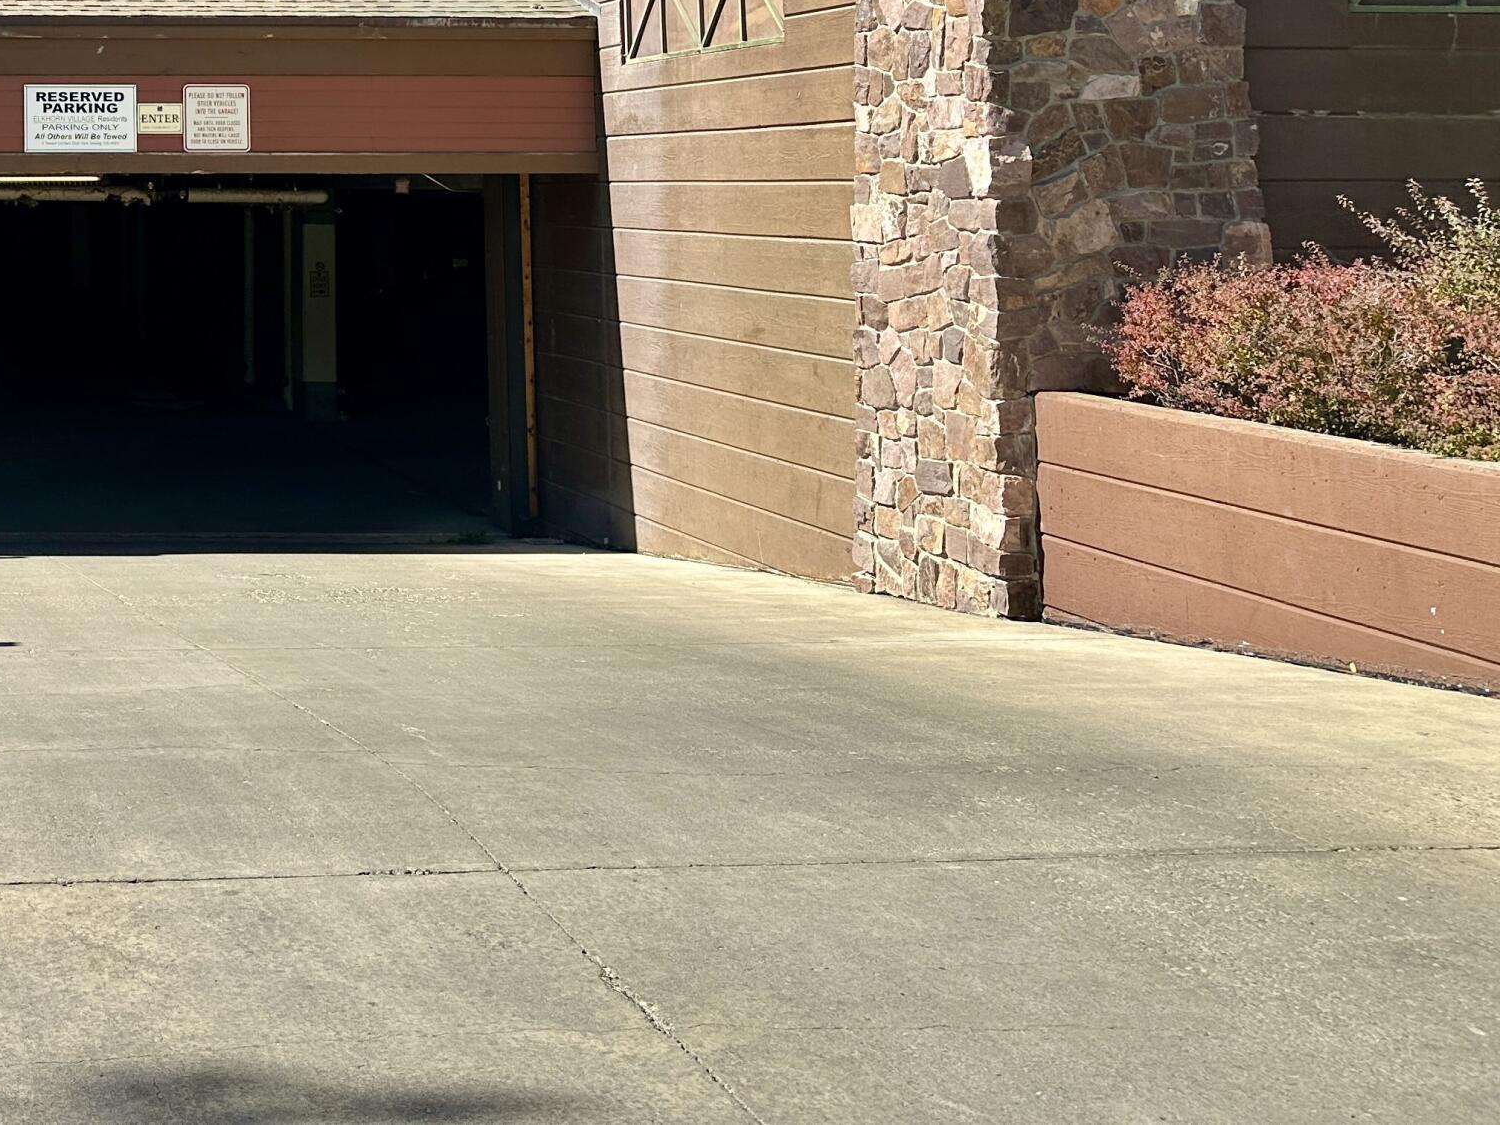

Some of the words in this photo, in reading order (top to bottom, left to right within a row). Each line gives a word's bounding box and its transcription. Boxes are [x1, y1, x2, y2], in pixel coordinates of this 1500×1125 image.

[36, 92, 124, 102] RESERVED
[43, 103, 118, 113] PARKING
[141, 114, 179, 124] ENTER
